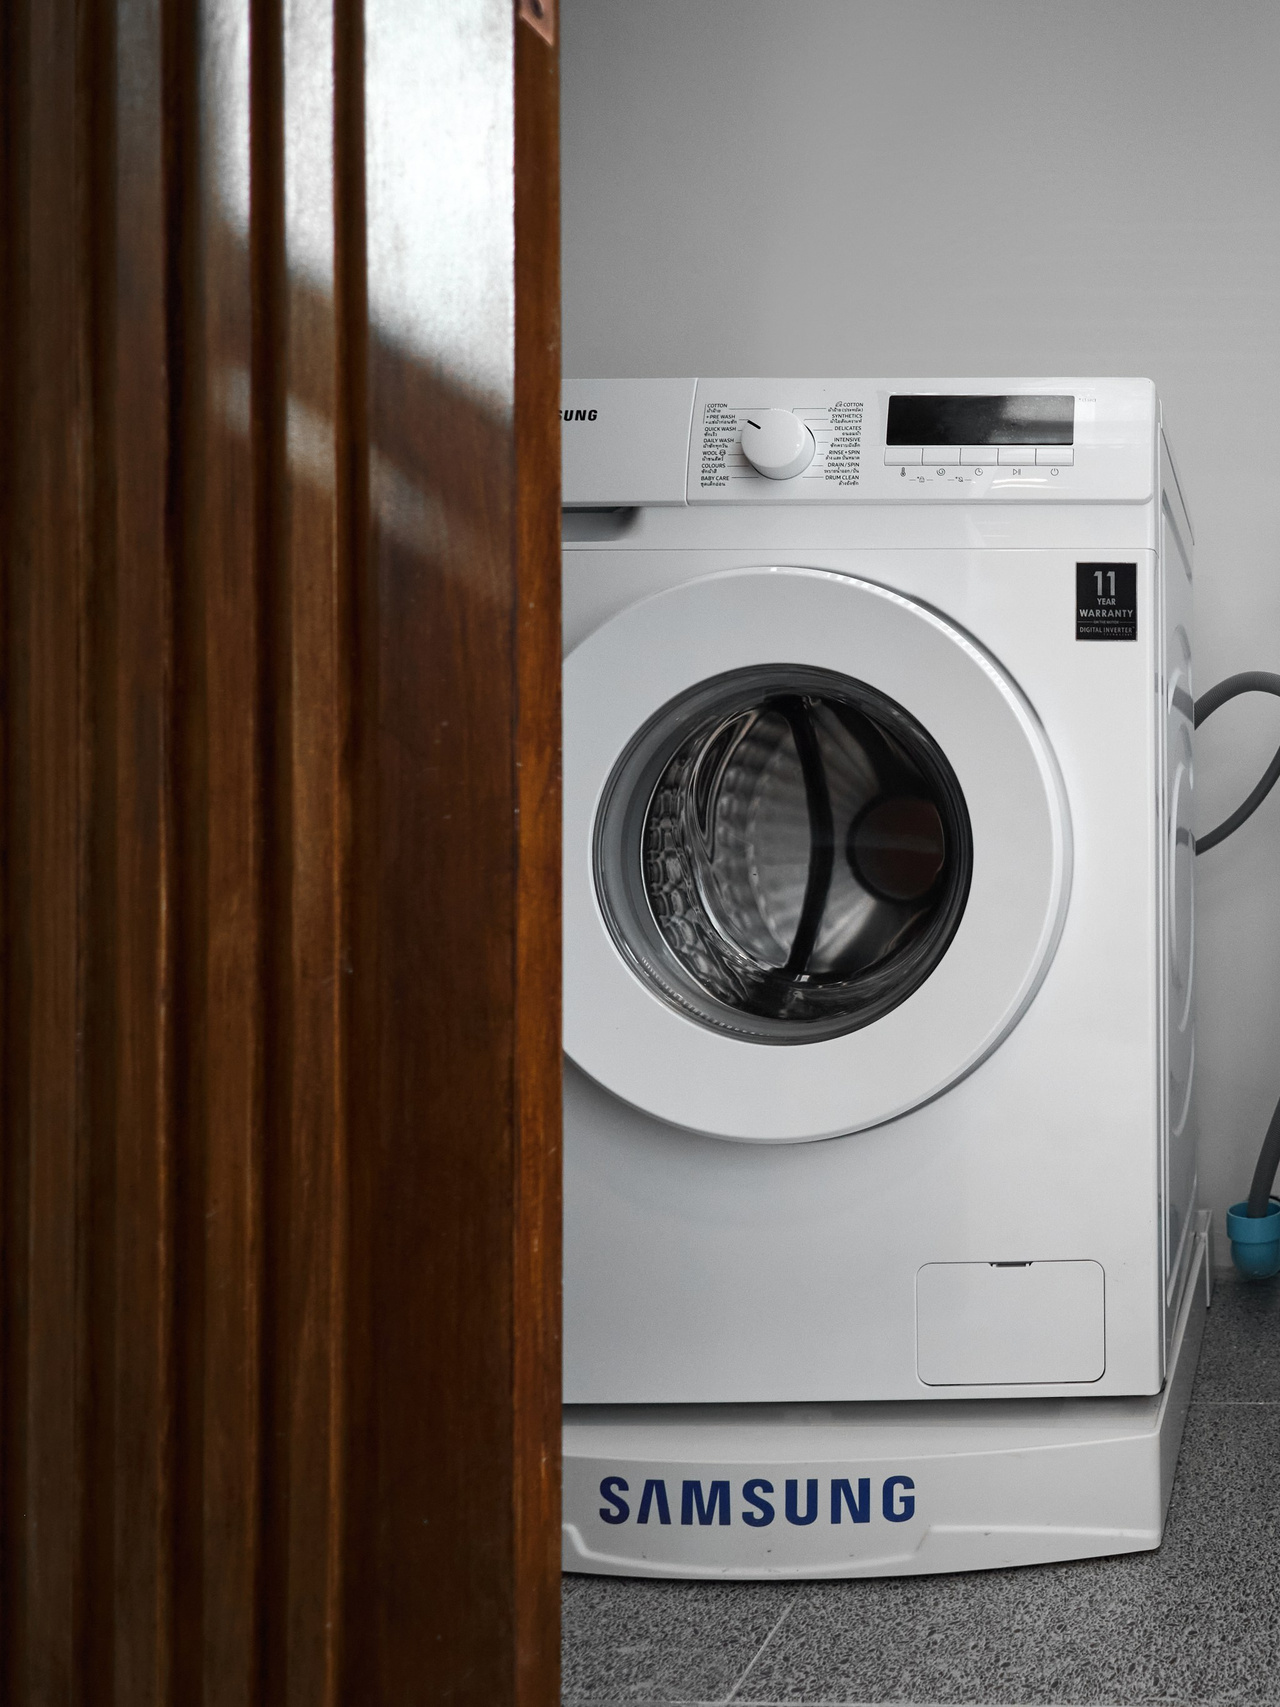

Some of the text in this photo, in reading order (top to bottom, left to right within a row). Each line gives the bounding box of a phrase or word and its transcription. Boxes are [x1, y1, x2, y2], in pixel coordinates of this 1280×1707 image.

[1094, 571, 1116, 596] 11
[1079, 609, 1133, 618] WARRANTY
[599, 1475, 915, 1527] SAMSUNG
